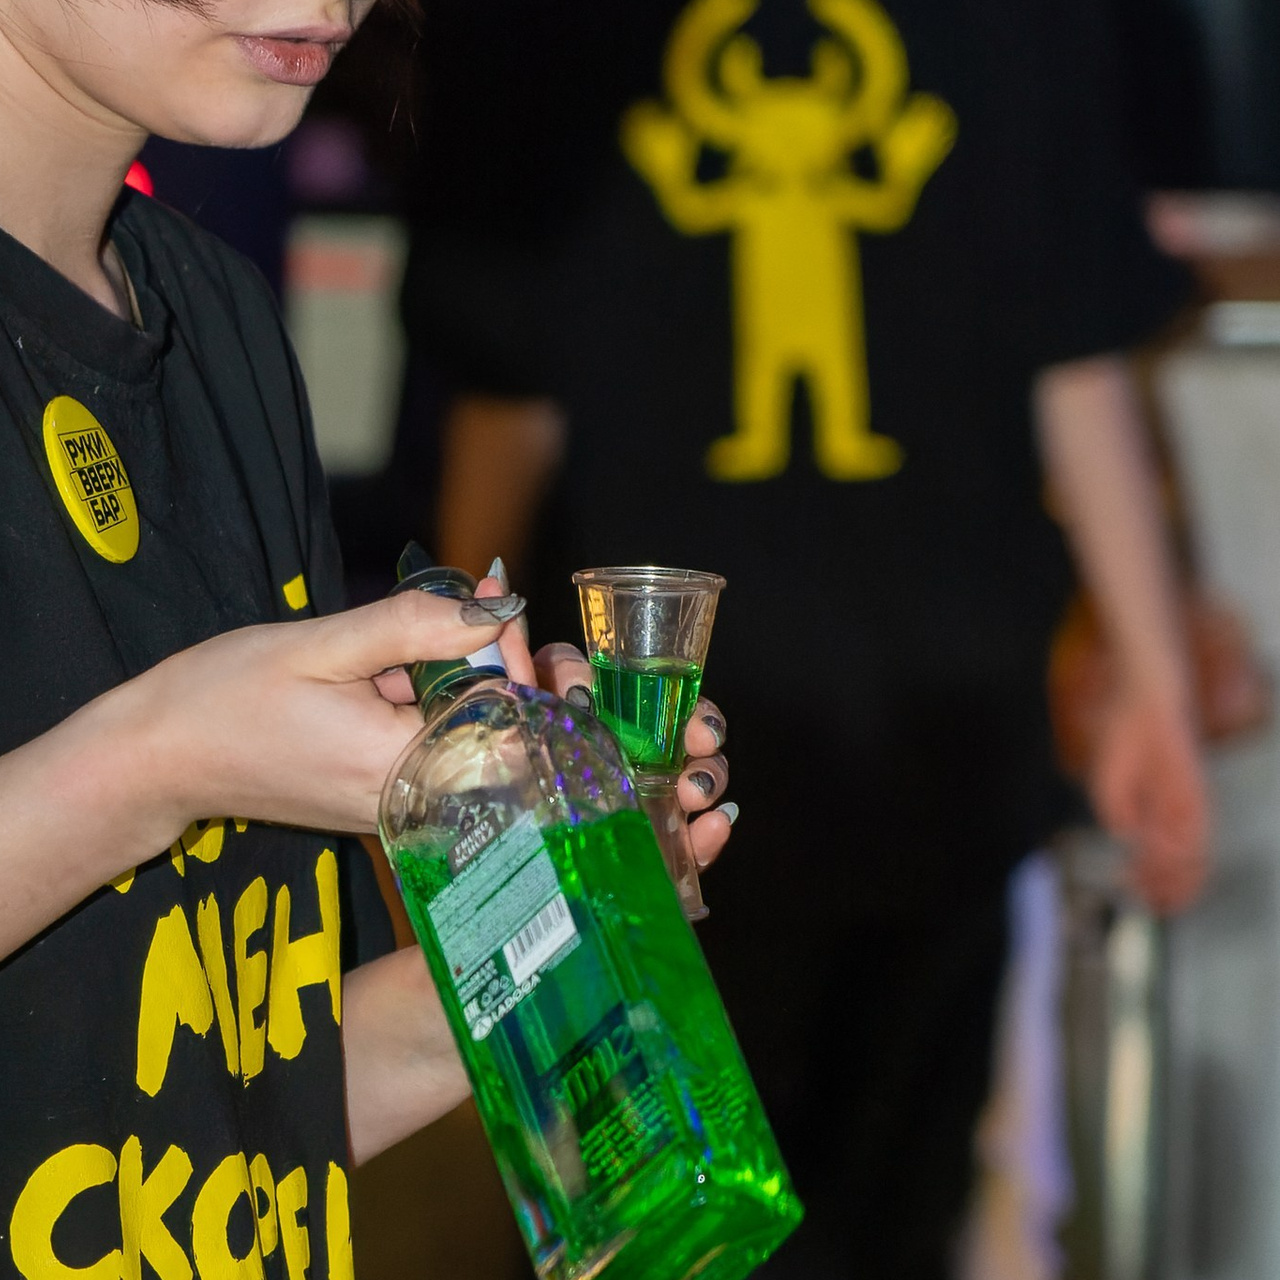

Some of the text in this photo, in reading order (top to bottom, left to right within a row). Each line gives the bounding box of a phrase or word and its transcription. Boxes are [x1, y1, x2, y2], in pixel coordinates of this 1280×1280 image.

[65, 431, 108, 466] РУКИ
[77, 459, 128, 496] ВВЕРХ
[90, 494, 121, 526] БАР
[491, 973, 542, 1022] LADOGA
